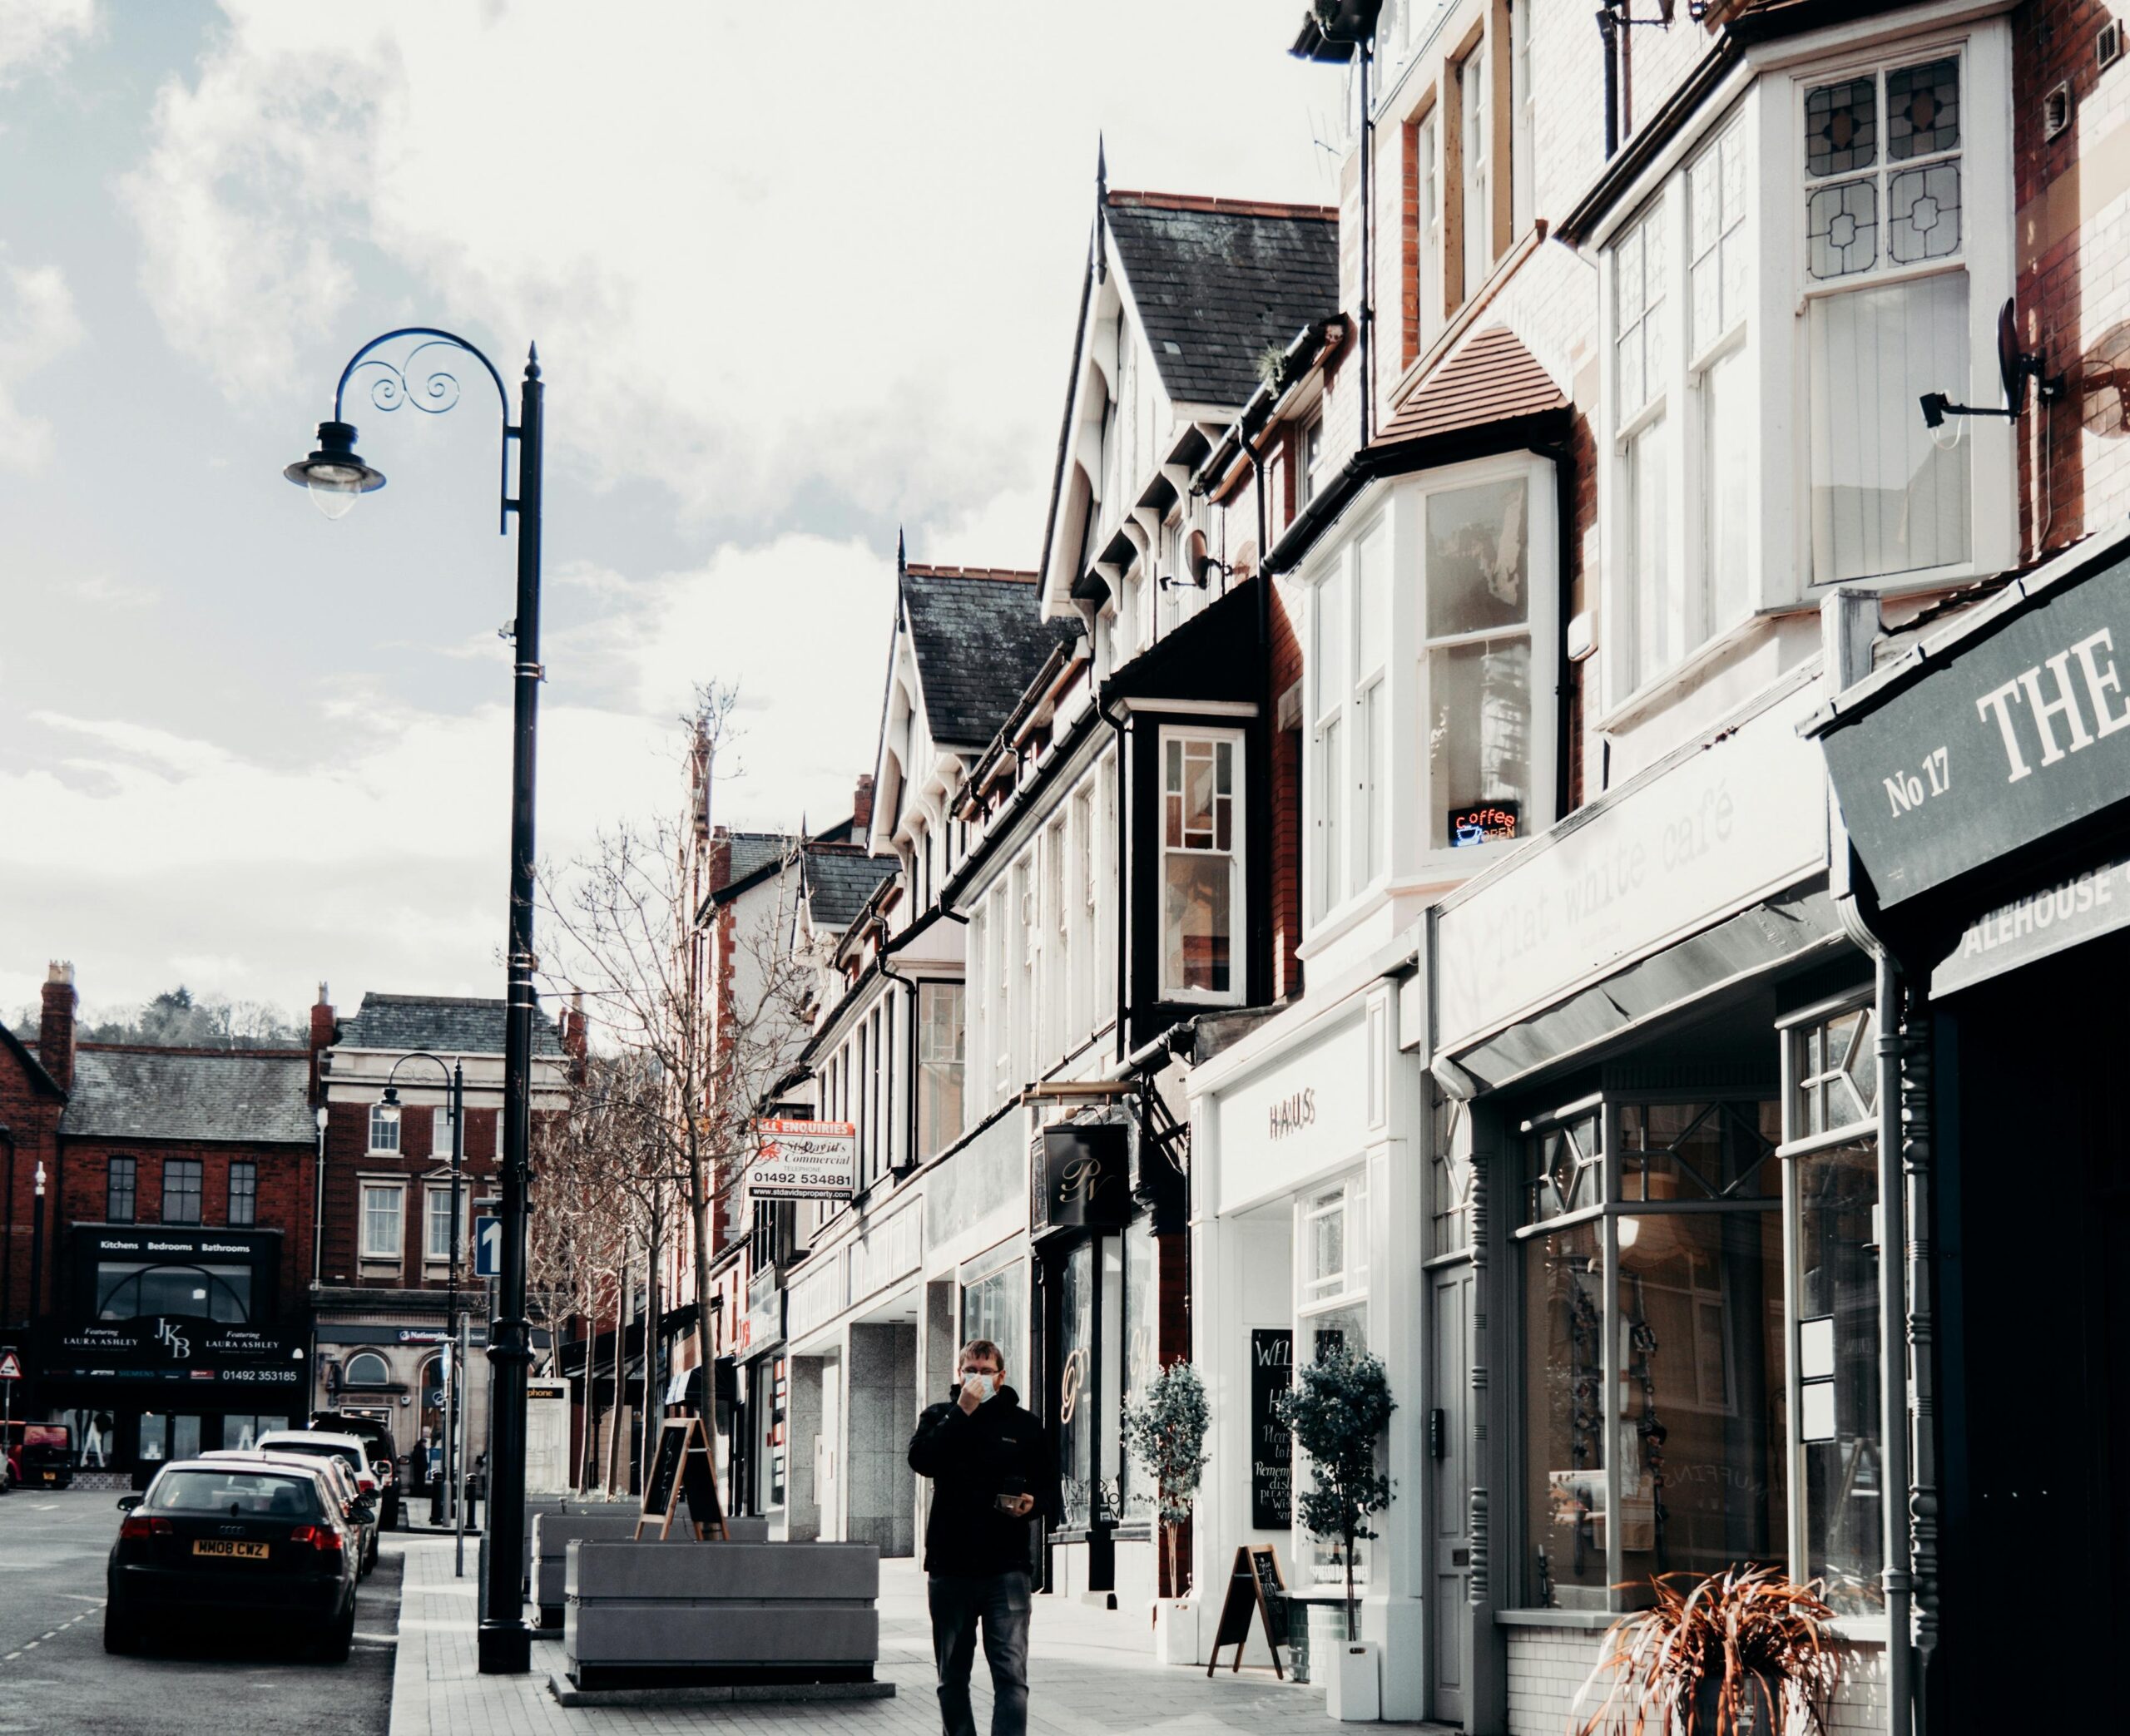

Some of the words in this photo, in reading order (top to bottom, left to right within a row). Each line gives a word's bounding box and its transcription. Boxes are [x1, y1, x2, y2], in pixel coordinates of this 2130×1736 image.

[1975, 626, 2130, 784] THE
[1882, 769, 1924, 819] No
[1922, 746, 1949, 799] 17
[1481, 826, 1515, 843] OPEN
[1496, 890, 1551, 967] flat
[1564, 838, 1647, 925] white
[1662, 777, 1736, 873] café
[1964, 863, 2113, 959] ALEHOUSE
[1270, 1087, 1312, 1140] HAUS
[782, 1122, 849, 1135] ENQUIRIES
[804, 1140, 846, 1153] David's
[785, 1154, 850, 1165] Commercial
[754, 1172, 795, 1184] 01492
[800, 1174, 850, 1185] 534881
[753, 1188, 850, 1199] www.stdavidsproperty.com
[100, 1240, 139, 1250] Kitchens
[147, 1242, 193, 1252] Bedrooms
[201, 1243, 250, 1253] Bathrooms
[84, 1327, 120, 1337] Featuring
[225, 1330, 260, 1339] Featuring
[63, 1337, 97, 1346] LAURA
[99, 1338, 139, 1347] ASHLEY
[206, 1339, 239, 1348] LAURA
[240, 1341, 280, 1349] ASHLEY
[222, 1370, 255, 1381] 01492
[257, 1370, 298, 1382] 353185
[1263, 1423, 1291, 1443] Pleas
[1255, 1461, 1291, 1476] Remem
